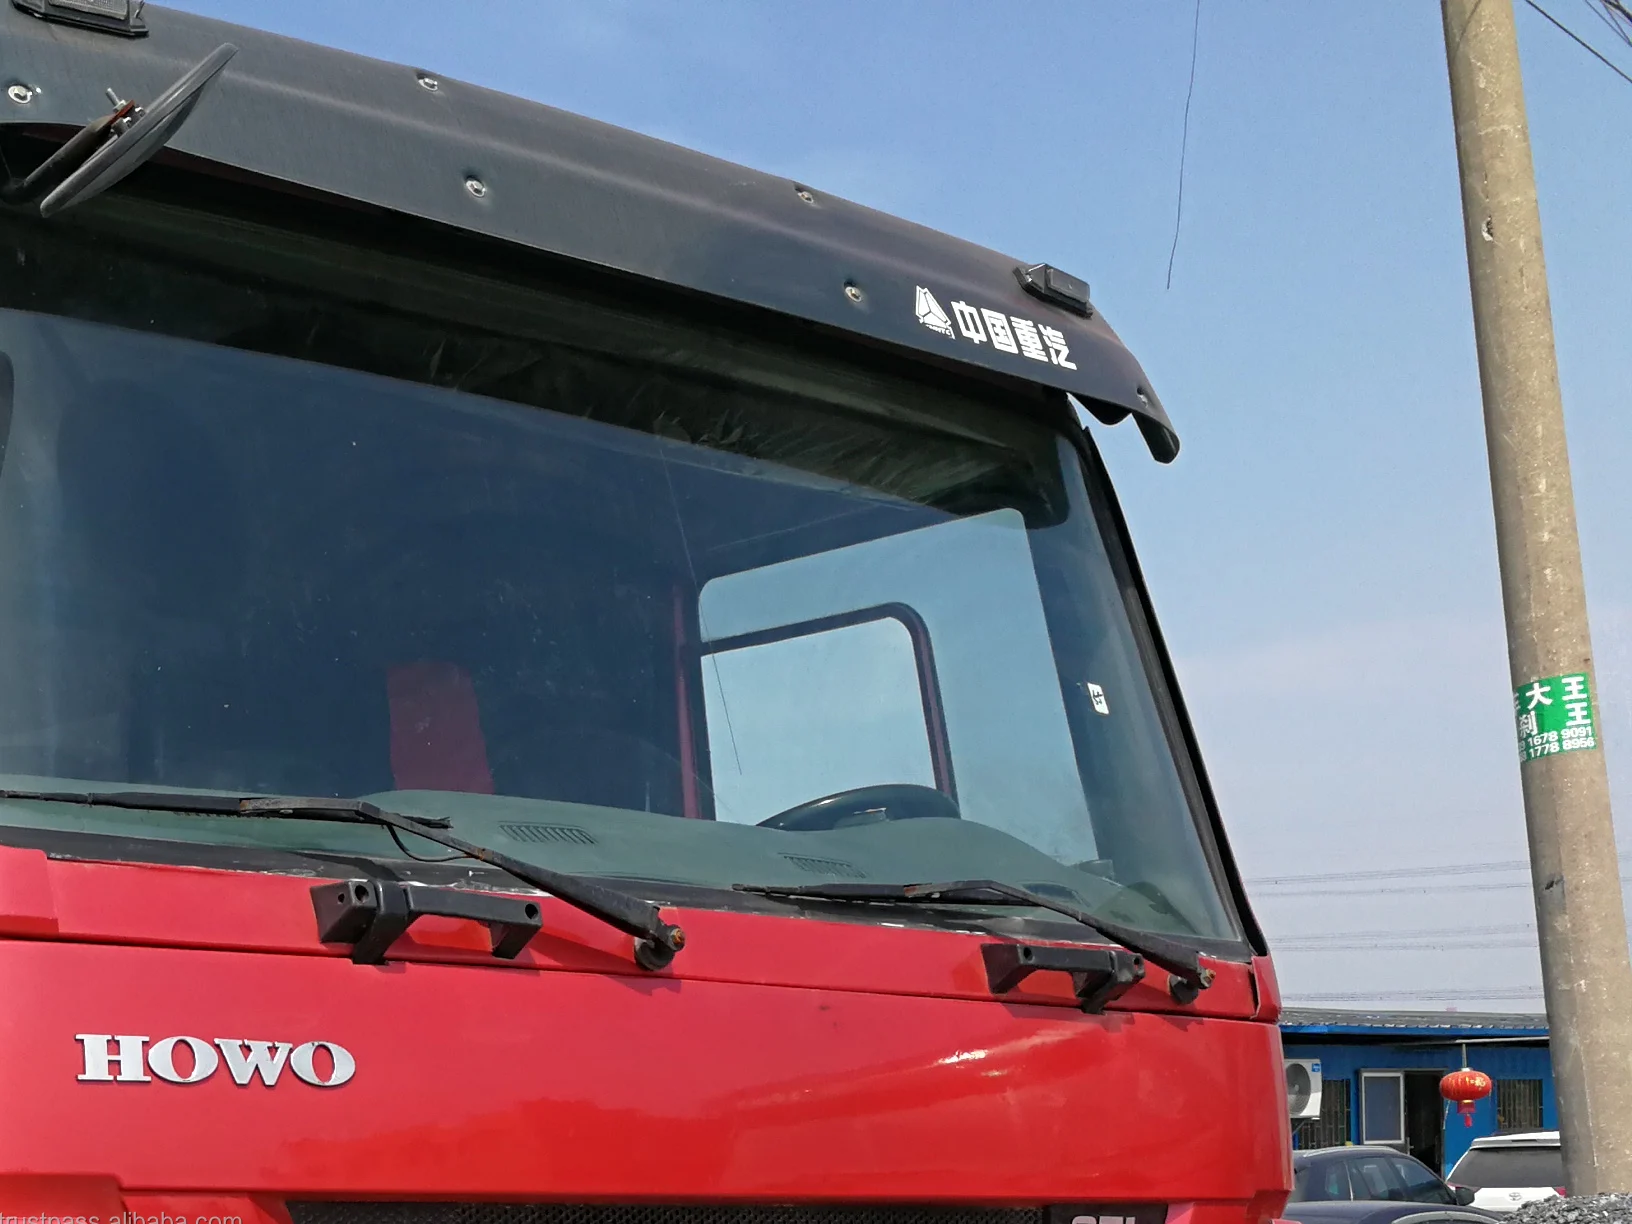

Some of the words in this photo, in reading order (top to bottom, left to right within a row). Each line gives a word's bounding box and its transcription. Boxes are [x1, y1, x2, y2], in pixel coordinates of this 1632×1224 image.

[951, 301, 1077, 370] 中国重汽
[1565, 702, 1591, 726] 王
[1527, 731, 1558, 746] 1678
[1561, 726, 1592, 739] 9091
[1529, 742, 1559, 758] 1778
[75, 1033, 356, 1087] HOWO
